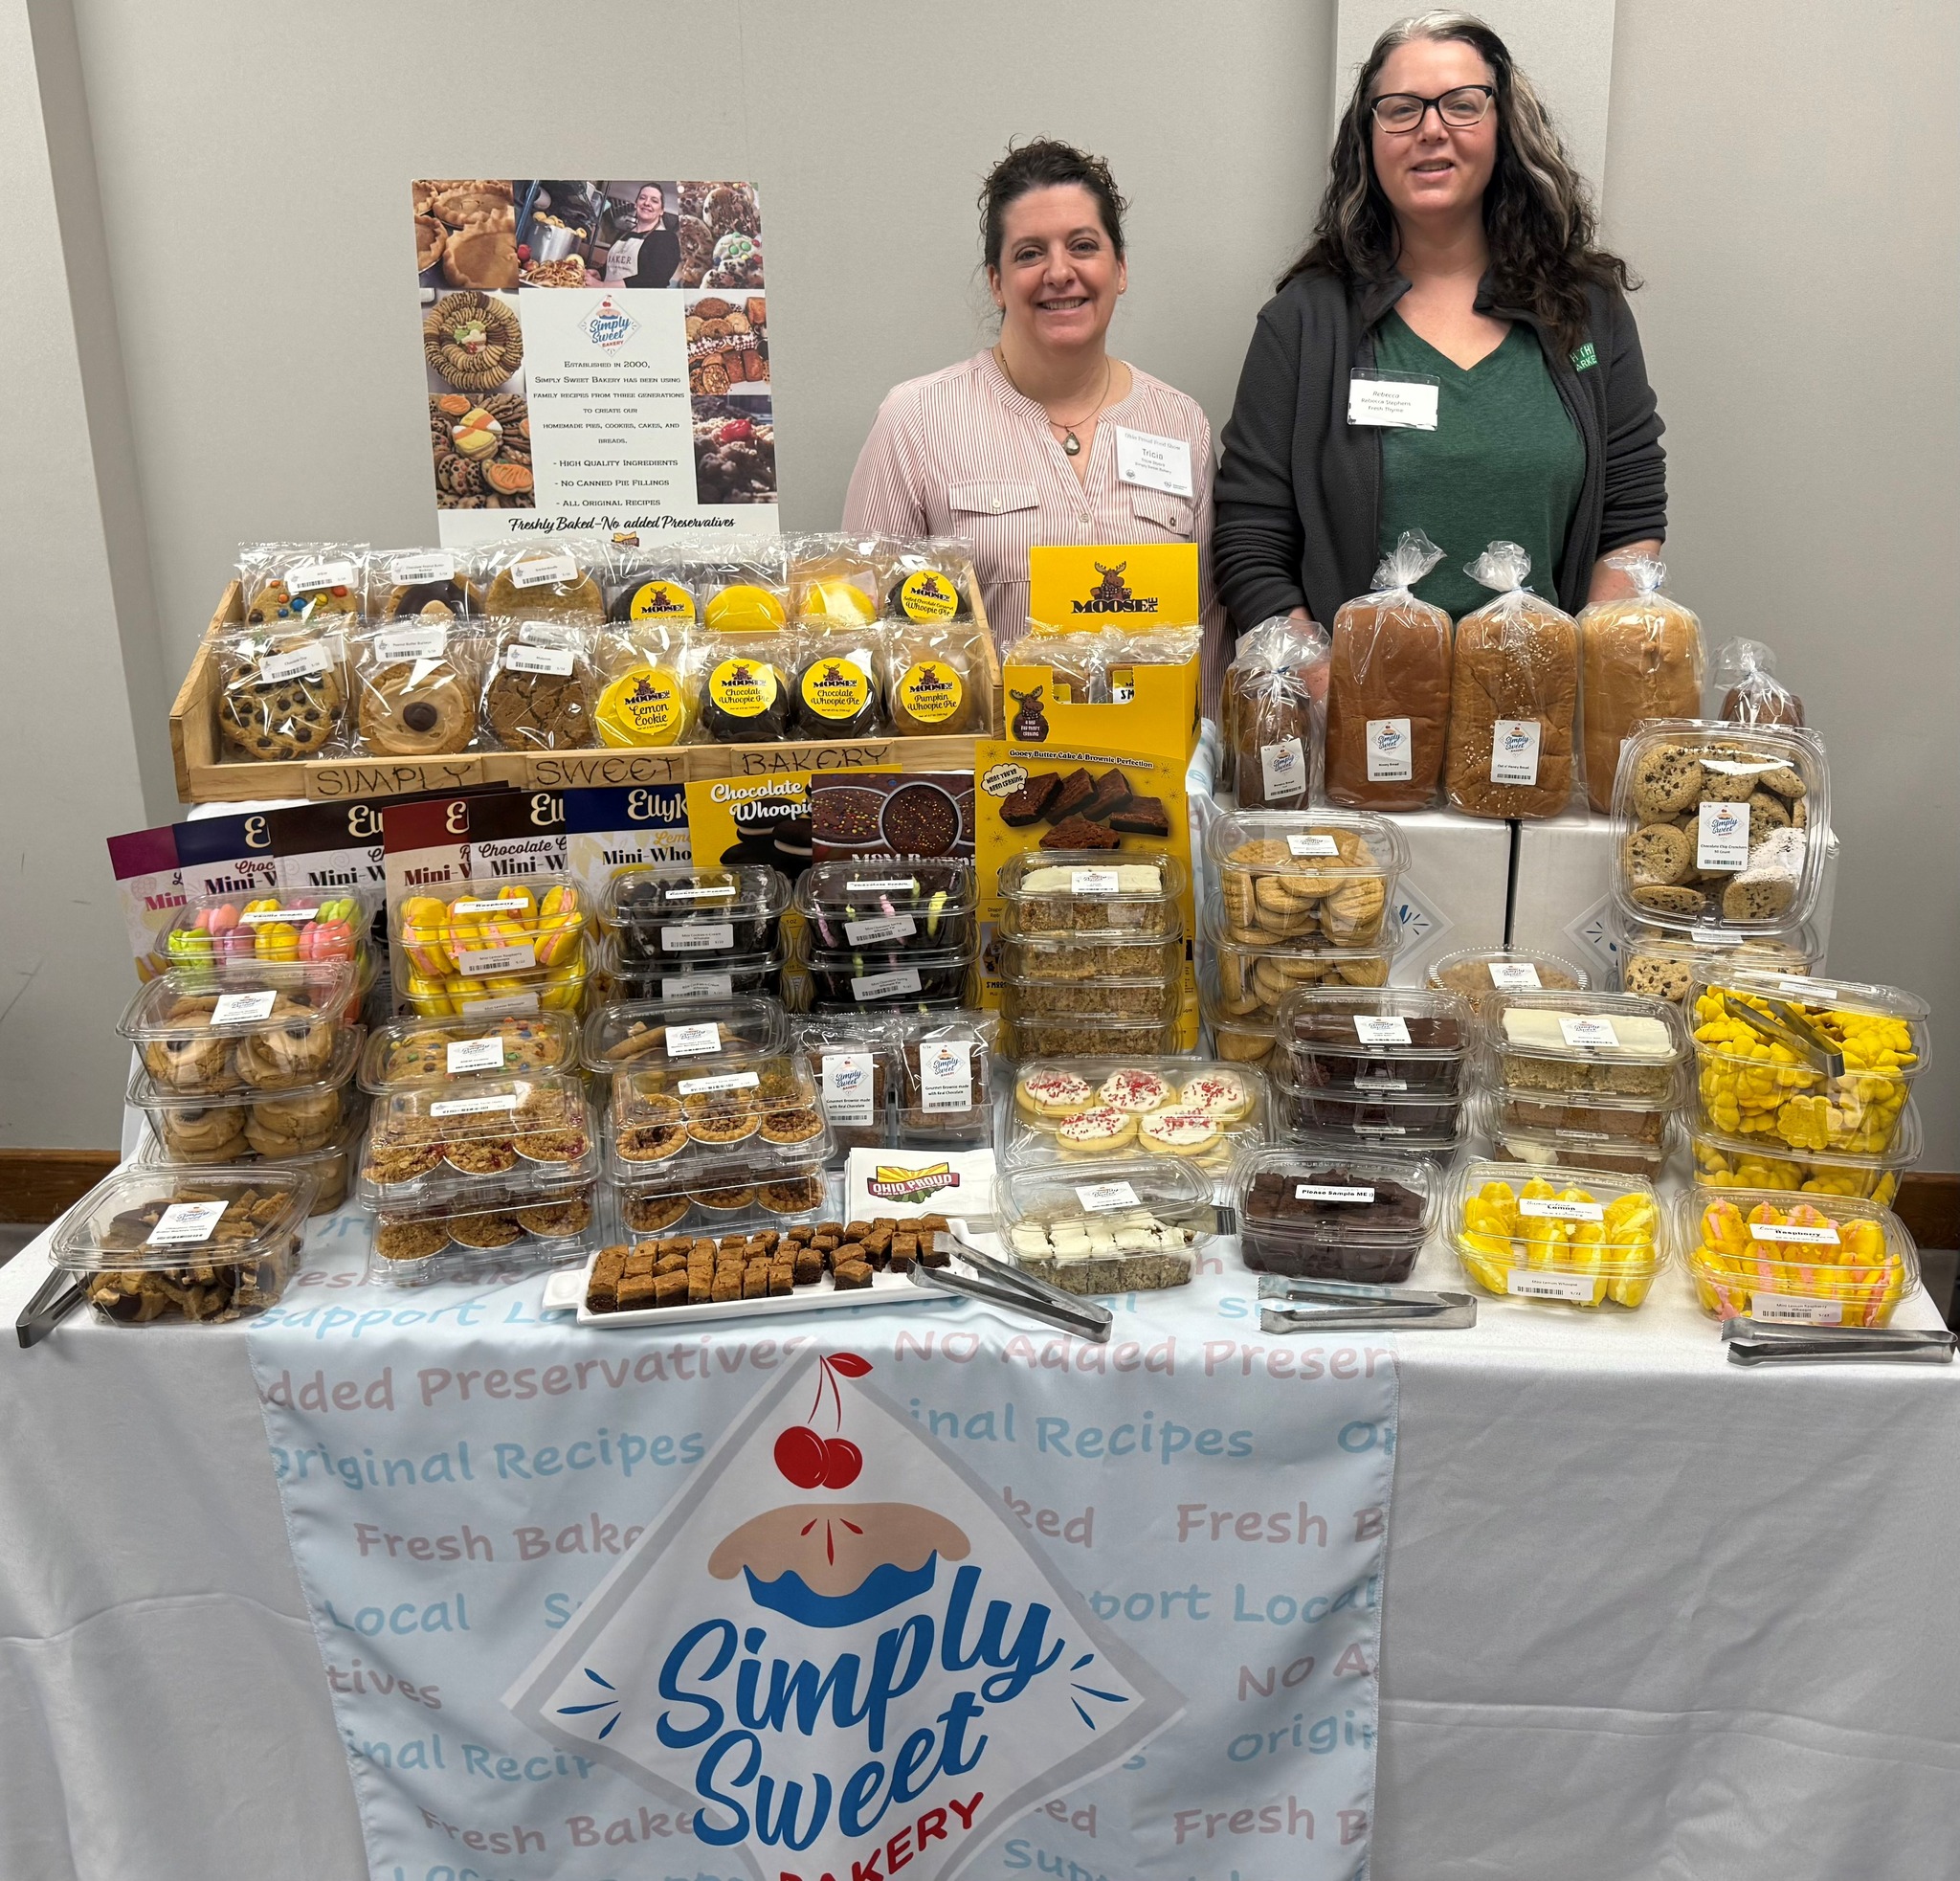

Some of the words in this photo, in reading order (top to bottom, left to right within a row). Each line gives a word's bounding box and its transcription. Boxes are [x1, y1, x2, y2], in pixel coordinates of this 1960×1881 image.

[590, 315, 632, 334] Simply
[591, 330, 624, 344] Sweet
[1372, 391, 1400, 399] Rebecca
[1142, 448, 1164, 460] Tricia
[508, 518, 555, 533] Freshly
[623, 516, 660, 529] added
[661, 515, 736, 529] Preservatives
[905, 602, 938, 615] Whoopie
[1070, 597, 1149, 615] MOOSE
[719, 695, 756, 705] Whoopie
[811, 697, 846, 706] Whoopie
[846, 697, 860, 706] Pie
[816, 688, 854, 698] Chocolate
[914, 693, 949, 704] Pumpkin
[629, 703, 670, 716] Lemon
[907, 702, 944, 712] Whoopie
[943, 700, 957, 709] Pie
[635, 712, 669, 727] Cookie
[743, 747, 892, 775] BAKERY
[1009, 750, 1034, 758] Gooey
[1034, 750, 1058, 759] Butter
[1058, 751, 1077, 760] Cake
[1083, 753, 1116, 764] Brownie
[1116, 757, 1154, 769] Perfection
[317, 765, 472, 796] SIMPLY
[536, 758, 680, 786] SWEET
[710, 780, 804, 804] Chocolate
[1711, 817, 1738, 829] Simply
[479, 840, 553, 859] Chocolate
[933, 1057, 960, 1070] Simply
[935, 1065, 955, 1075] Sweet
[835, 1070, 863, 1082] Simply
[835, 1079, 858, 1088] Sweet
[872, 1182, 905, 1194] OHIO
[905, 1174, 953, 1190] PROUD
[894, 1330, 981, 1363] NO
[1000, 1334, 1177, 1377] Added
[1036, 1411, 1255, 1467] Recipes
[495, 1427, 706, 1480] Recipes
[1176, 1500, 1329, 1548] Fresh
[352, 1521, 493, 1563] Fresh
[323, 1593, 471, 1638] Local
[657, 1564, 1066, 1753] Simply
[1236, 1655, 1316, 1702] NO
[692, 1691, 990, 1852] Sweet
[417, 1804, 546, 1855] Fresh
[1173, 1795, 1315, 1846] Fresh
